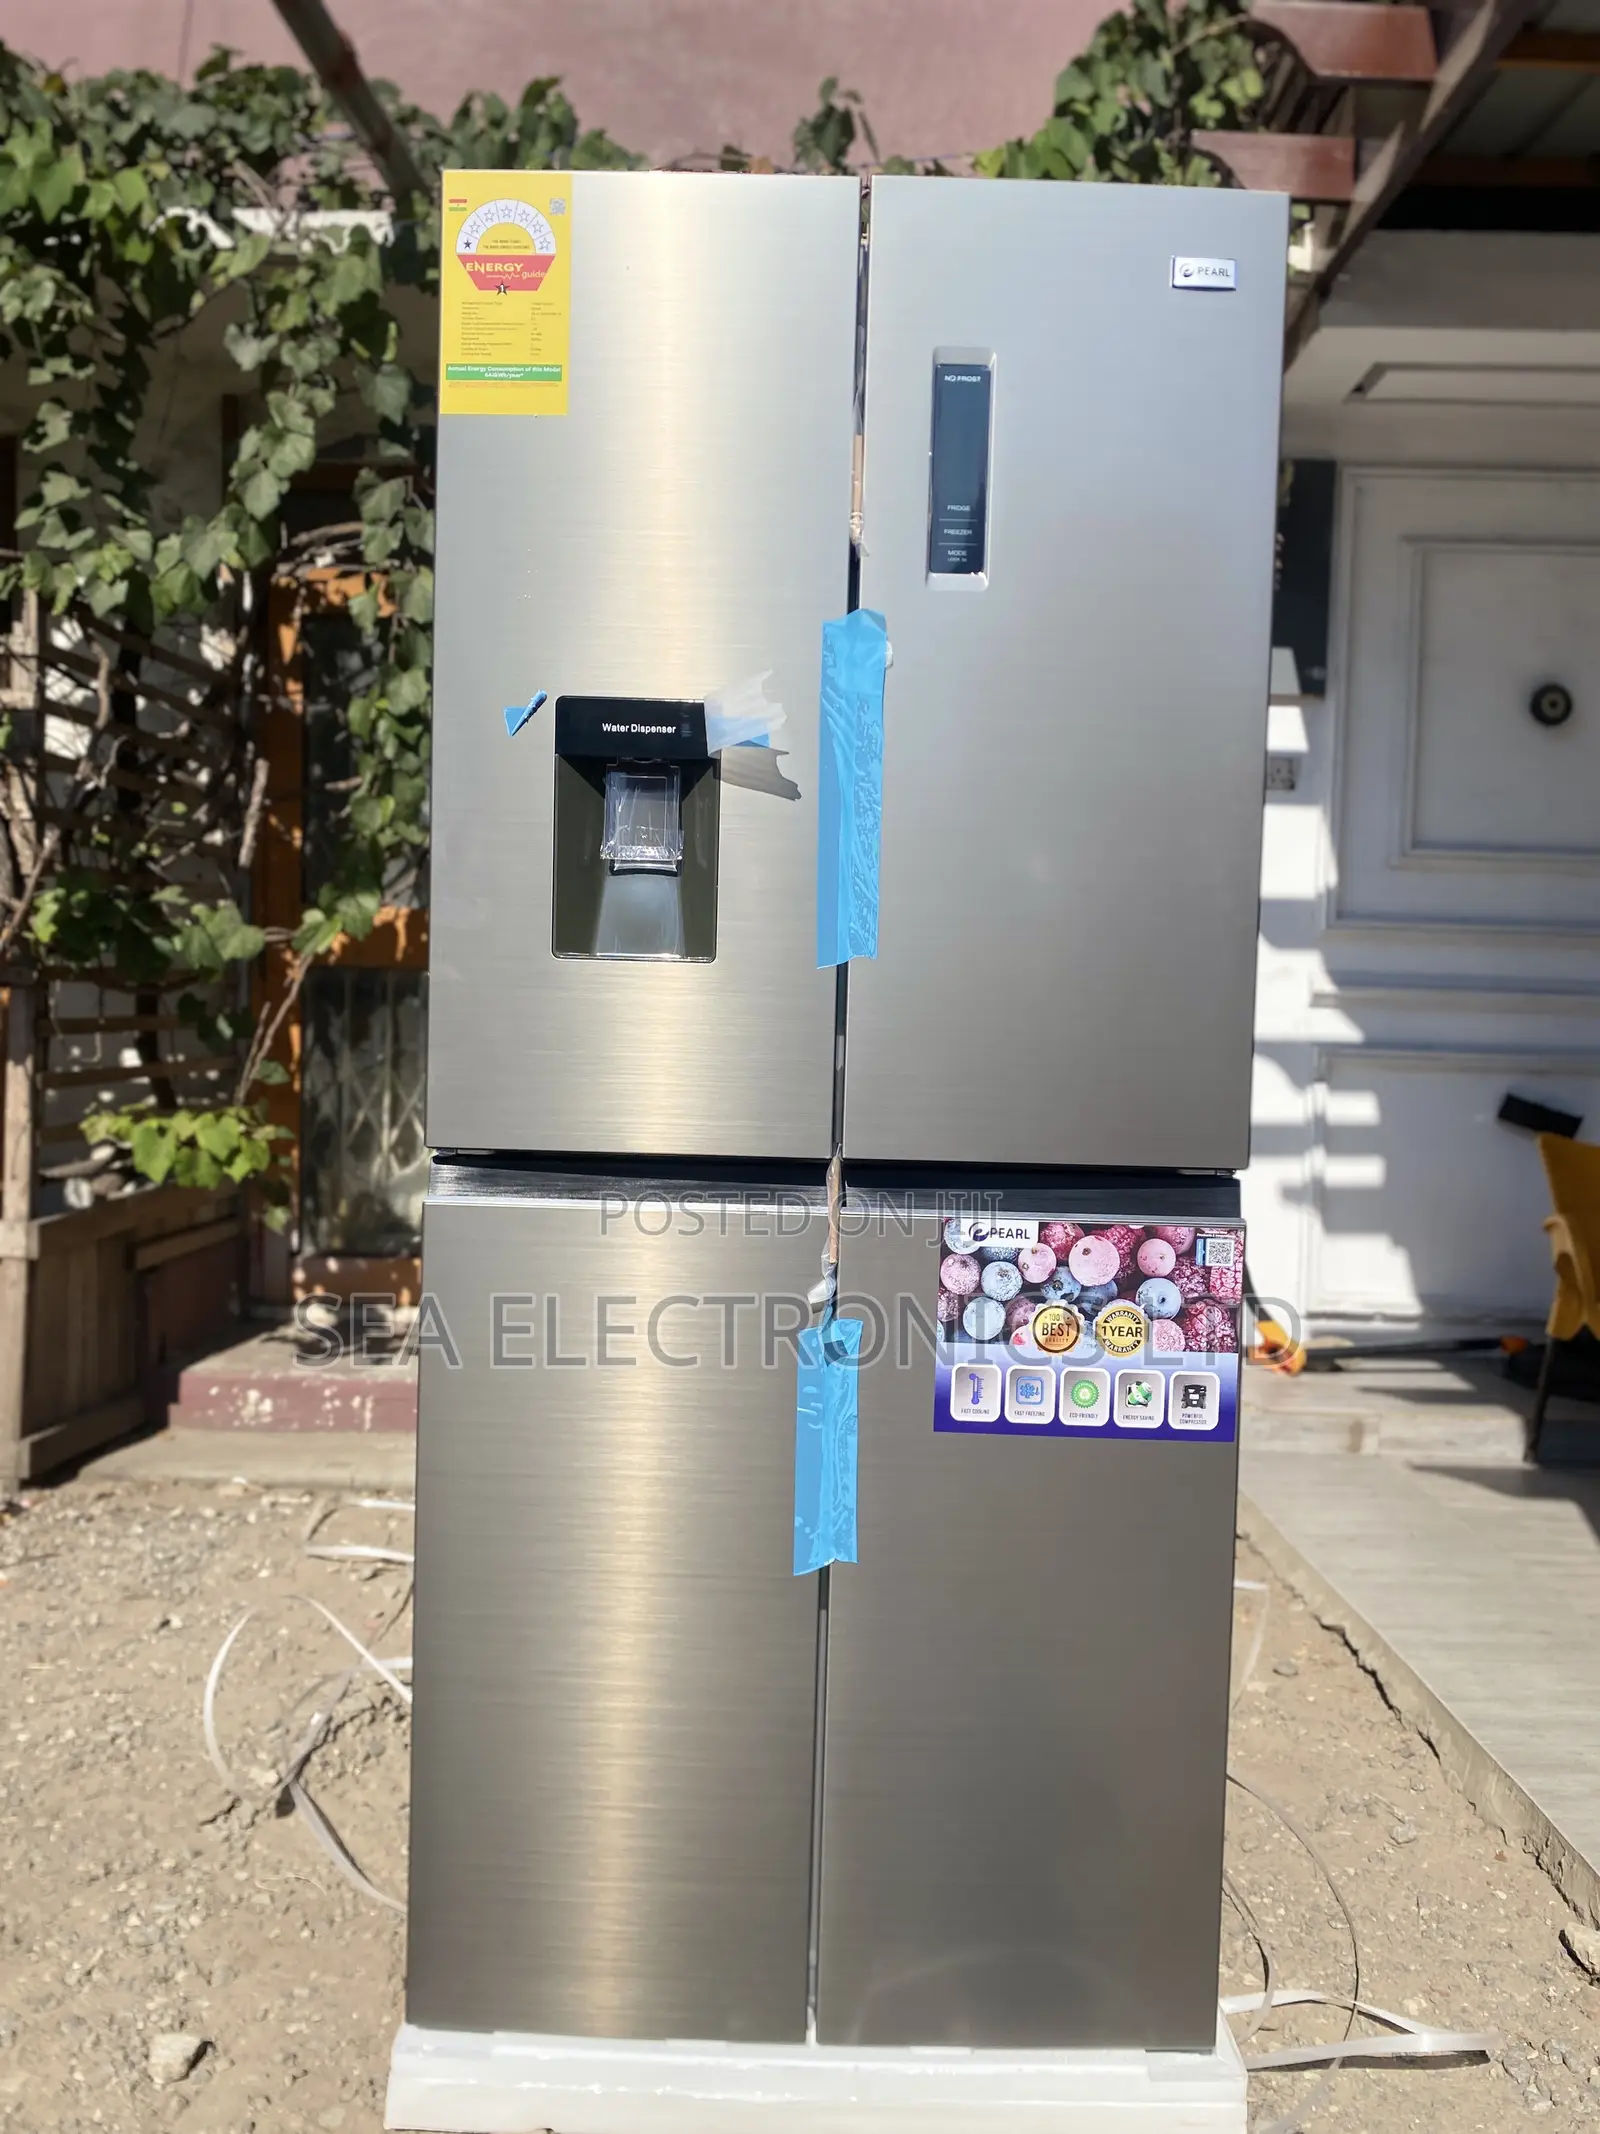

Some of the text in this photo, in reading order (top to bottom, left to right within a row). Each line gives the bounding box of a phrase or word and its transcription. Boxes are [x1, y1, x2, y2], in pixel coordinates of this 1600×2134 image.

[466, 260, 524, 274] ENERGY
[1197, 266, 1231, 277] PEARL
[521, 270, 546, 280] guide
[944, 374, 981, 383] NO FROST
[947, 504, 971, 512] FRIDGE
[943, 528, 973, 536] FREEZER
[947, 549, 967, 557] MODE
[601, 722, 677, 735] Water Dispenser
[989, 1227, 1031, 1240] PEARL
[1105, 1310, 1142, 1324] WARRANTY
[1041, 1322, 1073, 1337] BEST
[1101, 1326, 1144, 1338] 1 YEAR
[1104, 1340, 1140, 1353] WARRANTY
